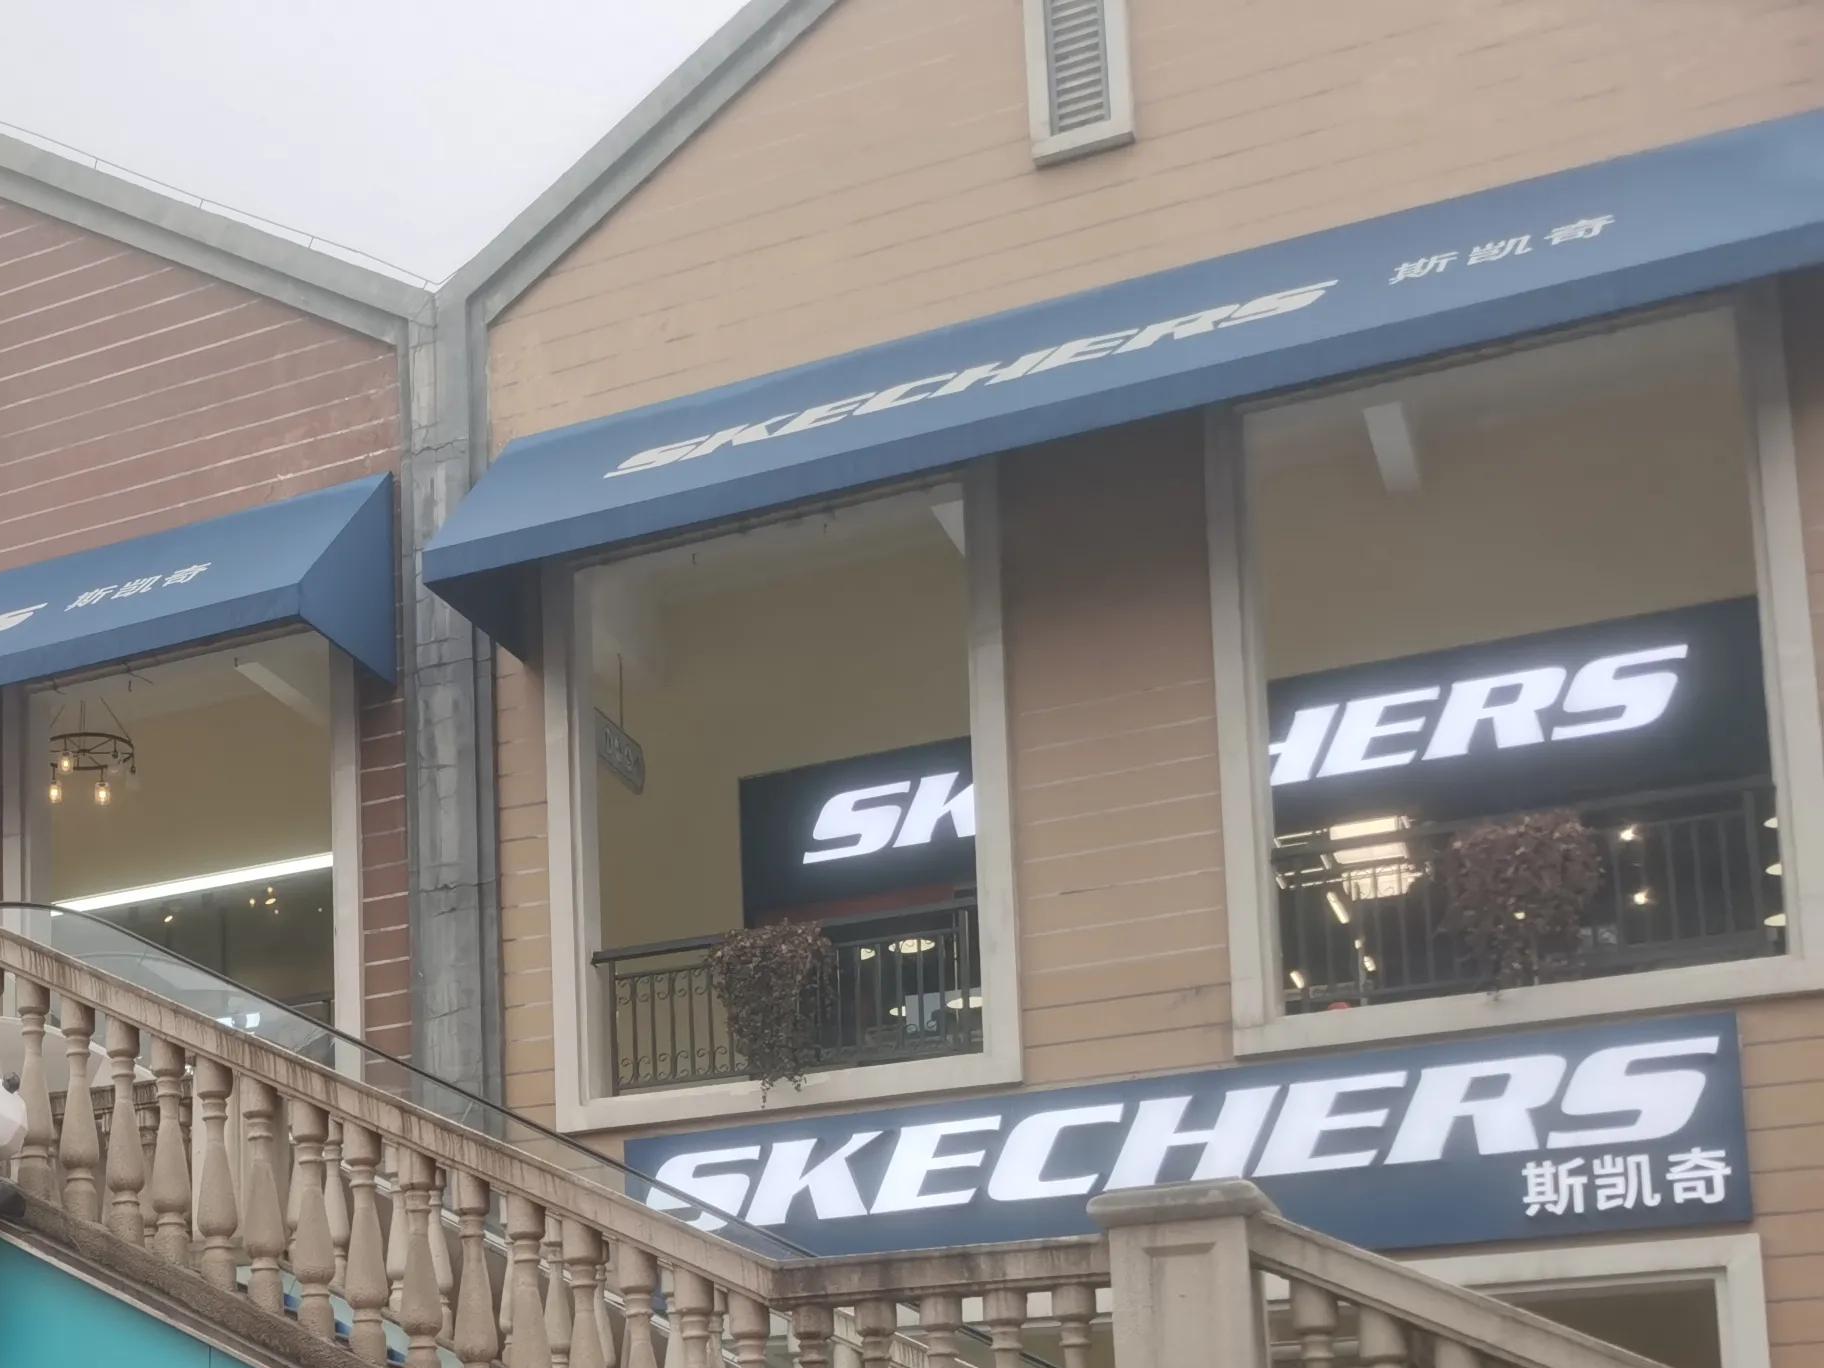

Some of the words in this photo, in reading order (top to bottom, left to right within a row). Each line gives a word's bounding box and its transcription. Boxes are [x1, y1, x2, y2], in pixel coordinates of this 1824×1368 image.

[1388, 214, 1616, 285] 斯凯奇
[603, 279, 1339, 480] SKECHERS
[64, 562, 212, 612] 斯凯奇
[645, 1036, 1720, 1232] SKECHERS
[1521, 1147, 1732, 1216] 斯凯奇
